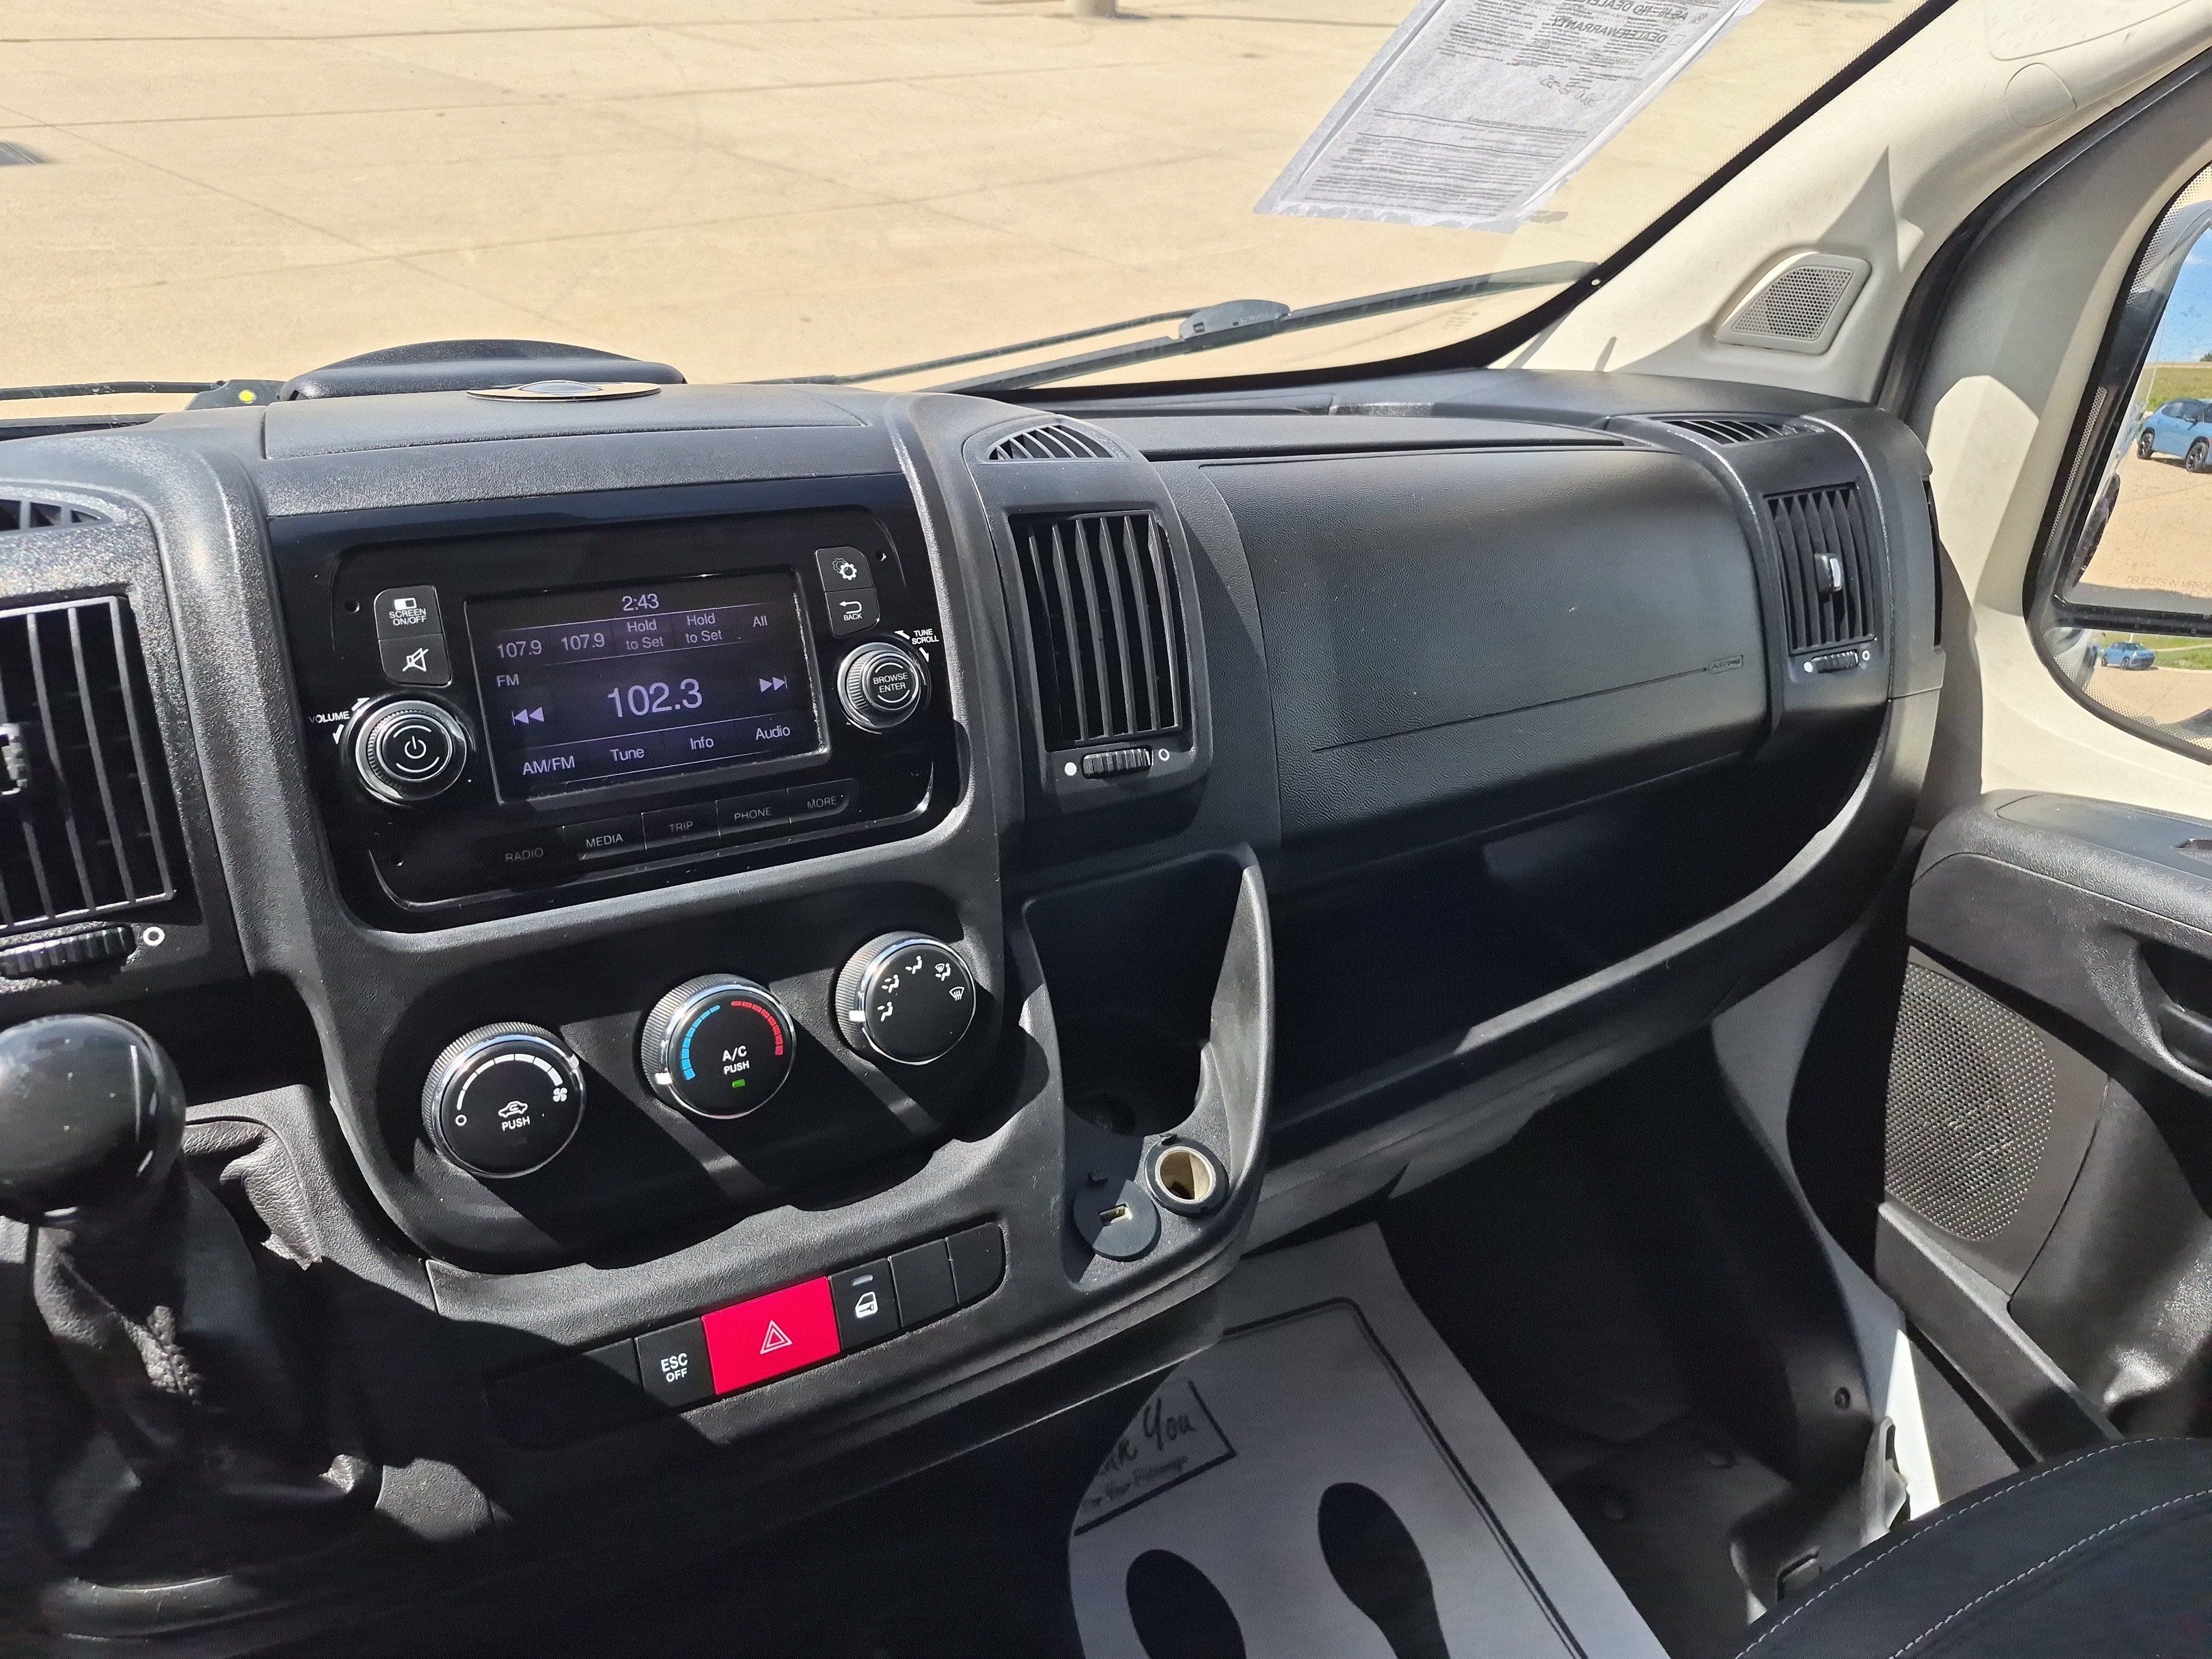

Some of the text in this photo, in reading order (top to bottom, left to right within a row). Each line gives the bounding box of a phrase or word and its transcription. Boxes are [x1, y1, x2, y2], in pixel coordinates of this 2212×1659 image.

[622, 594, 659, 611] 2:43
[389, 608, 427, 619] SCREEN
[393, 615, 427, 626] ON/OFF
[687, 613, 716, 626] Hold
[844, 613, 863, 621] BACK
[627, 619, 657, 633] Hold
[753, 615, 768, 628] All
[686, 629, 722, 644] to Set
[912, 635, 940, 645] SCROLL
[914, 628, 933, 638] TUNE
[497, 640, 542, 658] 107.9
[562, 633, 605, 651] 107.9
[626, 636, 664, 650] to Set
[497, 674, 519, 687] FM
[873, 672, 908, 685] BROWSE
[879, 682, 906, 693] ENTER
[608, 679, 702, 717] 102.3
[309, 710, 350, 724] VOLUME
[755, 725, 790, 741] Audio
[690, 736, 714, 750] Info
[610, 748, 644, 762] Tune
[523, 756, 575, 775] AM/FM
[807, 796, 837, 810] MORE
[734, 807, 771, 821] PHONE
[669, 821, 693, 833] TRIP
[586, 833, 623, 848] MEDIA
[505, 847, 544, 862] RADIO
[722, 1045, 747, 1062] A/C
[723, 1060, 750, 1075] PUSH
[501, 1116, 531, 1131] PUSH
[661, 1353, 689, 1373] ESC
[666, 1367, 688, 1382] OFF
